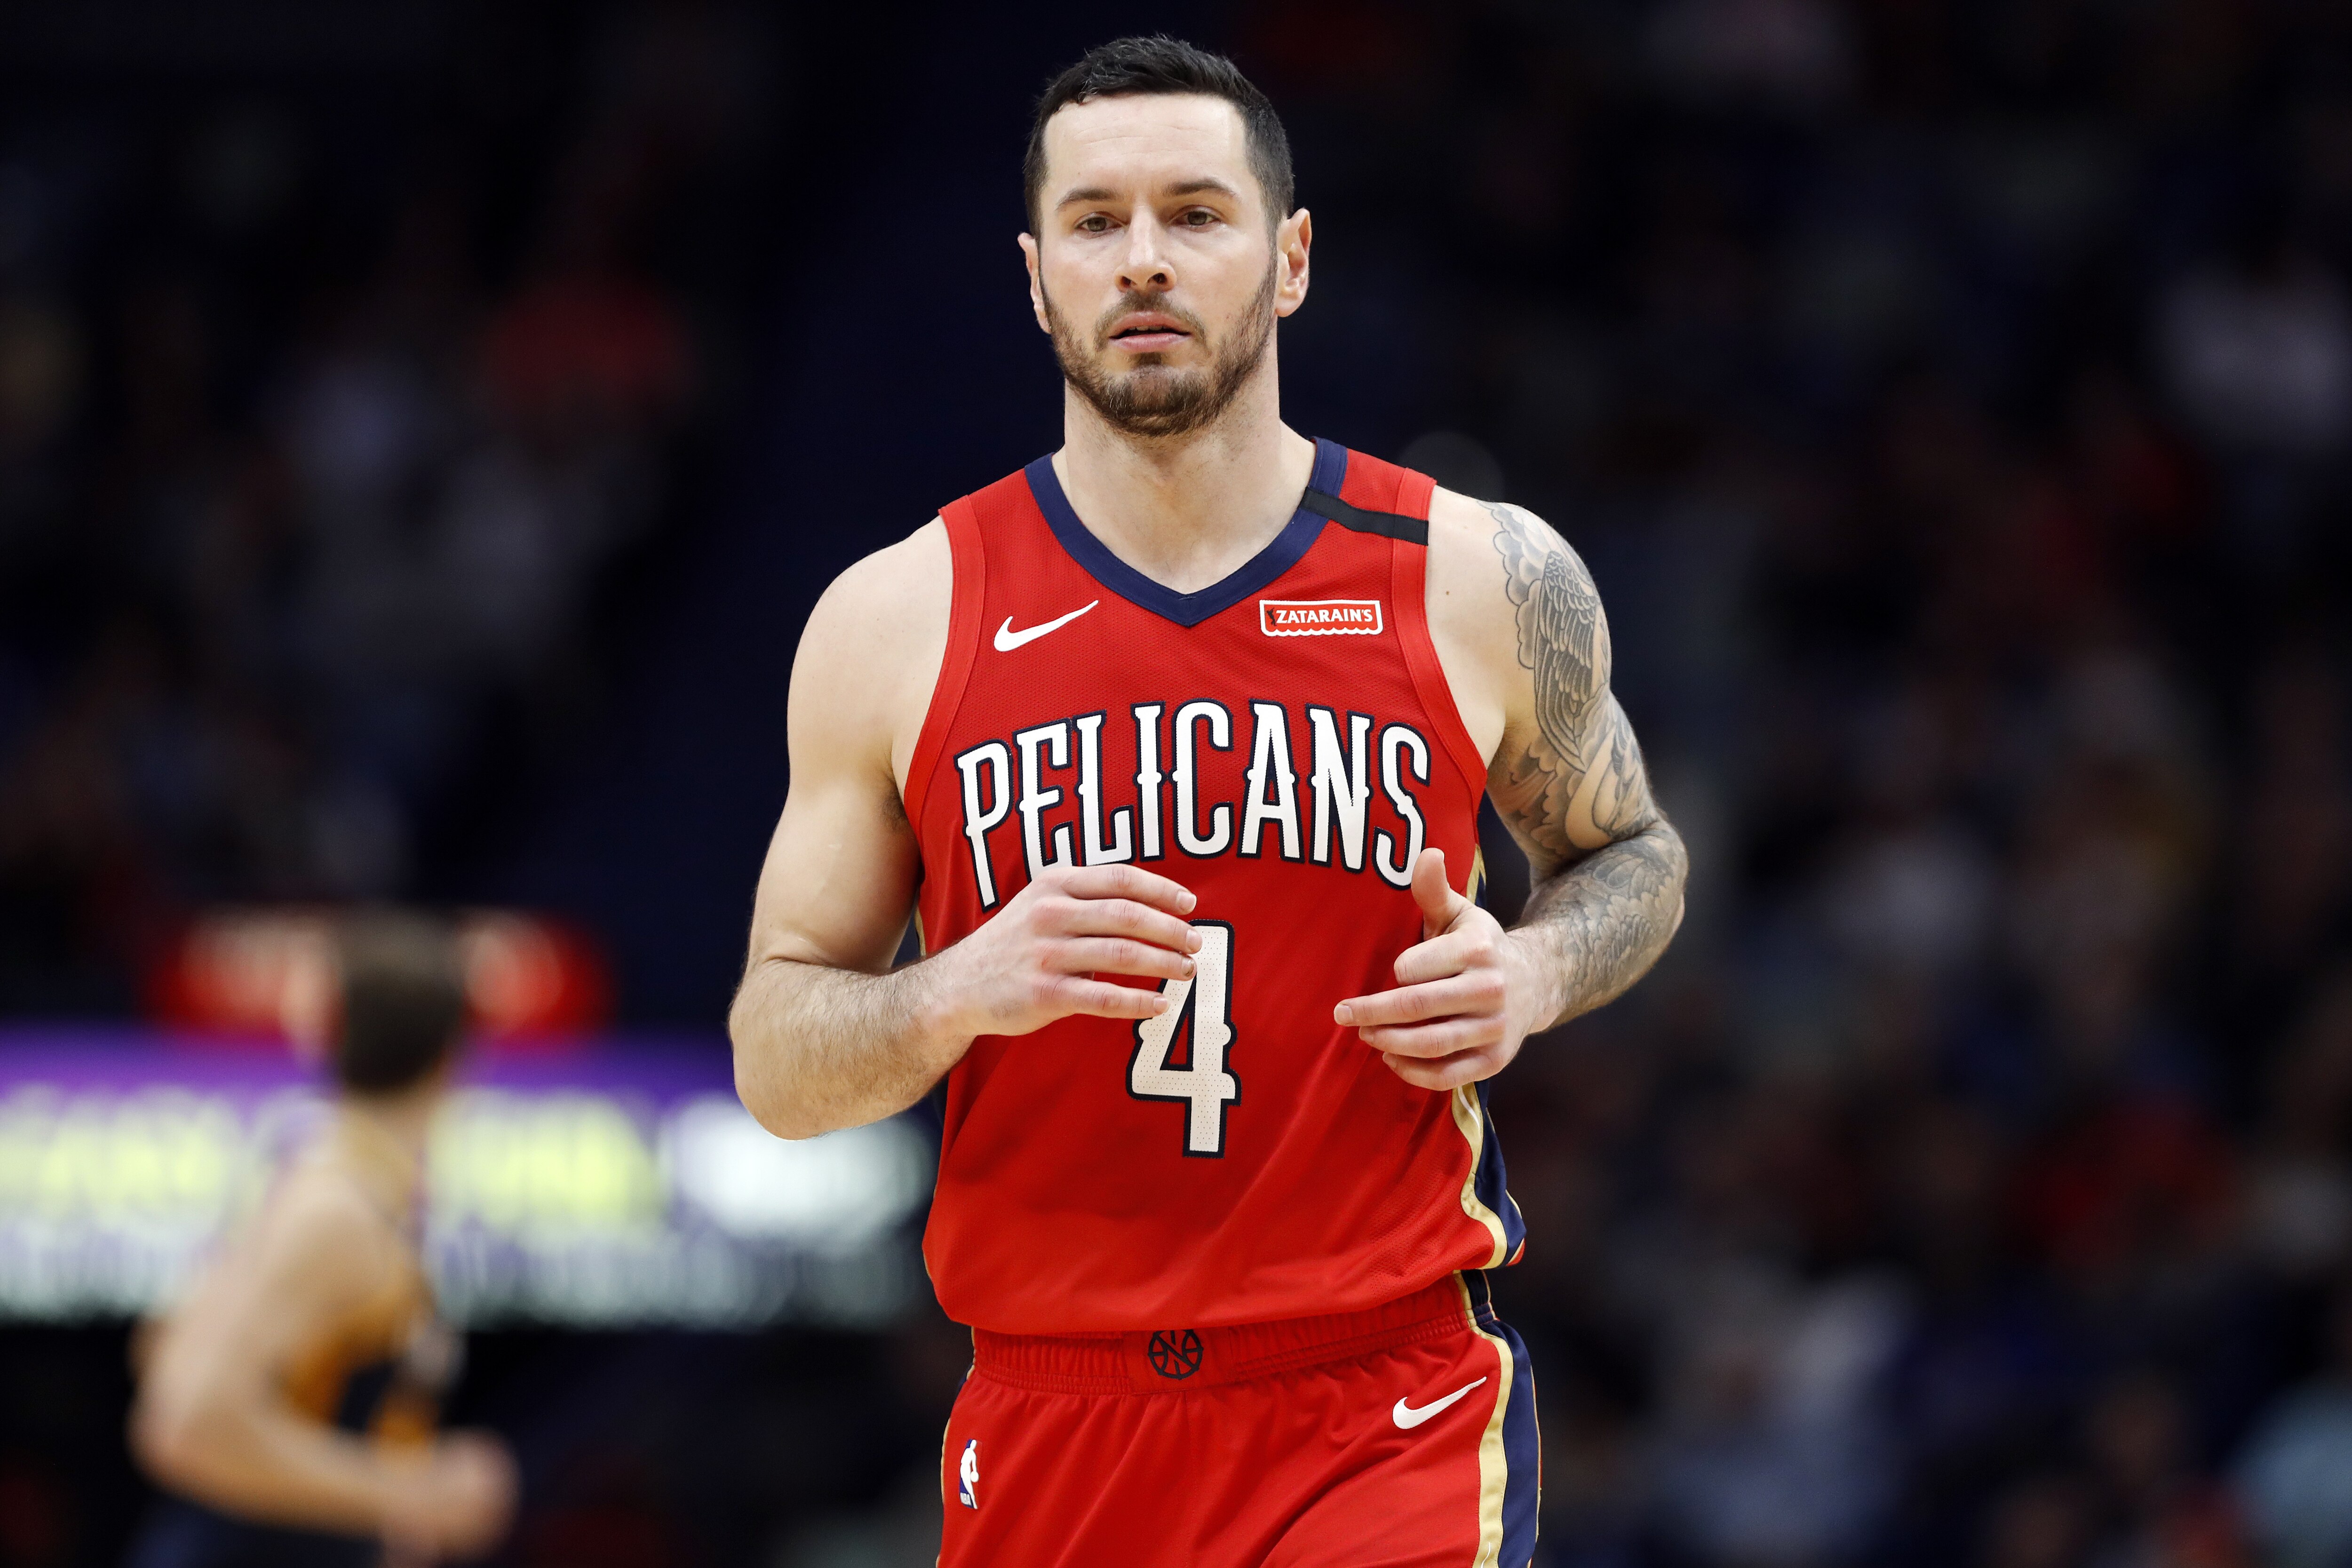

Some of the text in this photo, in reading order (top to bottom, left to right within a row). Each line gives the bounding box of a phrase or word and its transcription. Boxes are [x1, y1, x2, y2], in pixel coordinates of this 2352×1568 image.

[1275, 608, 1373, 624] ZATARAIN'S
[954, 698, 1432, 914] PELICANS
[1126, 919, 1242, 1158] 4
